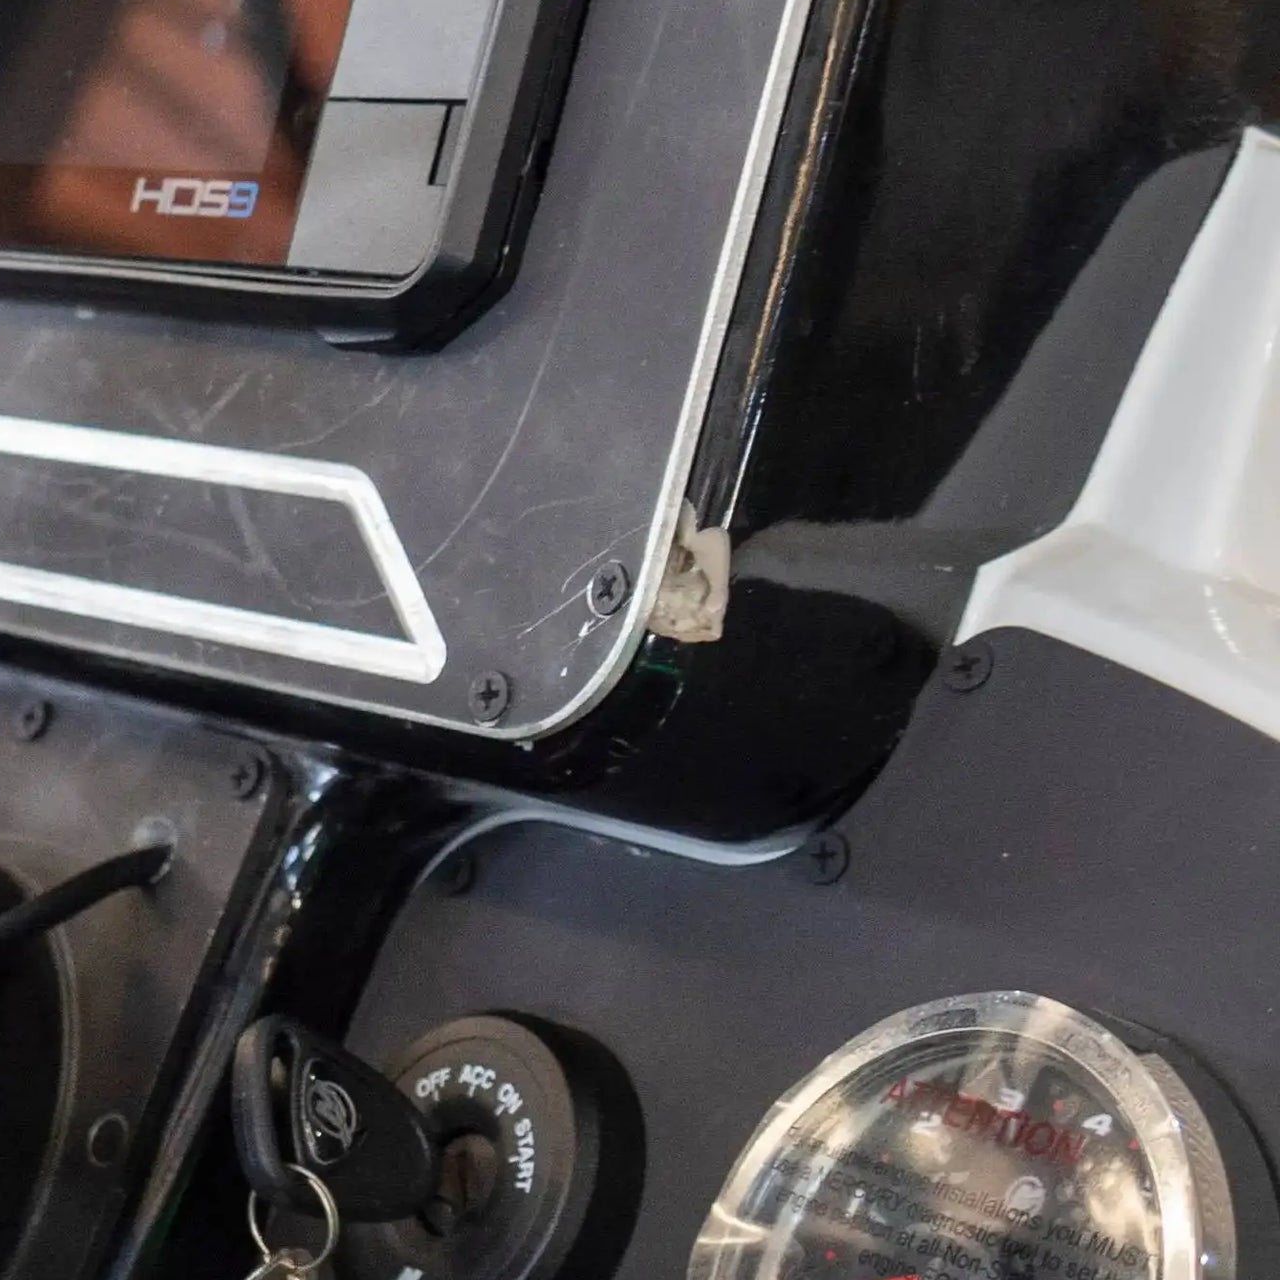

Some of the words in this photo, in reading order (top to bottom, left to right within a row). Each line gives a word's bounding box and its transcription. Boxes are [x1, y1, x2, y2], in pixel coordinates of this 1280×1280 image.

[415, 1067, 451, 1098] OFF
[458, 1064, 496, 1089] ACC
[497, 1083, 523, 1114] ON
[881, 1077, 1082, 1165] ATTENTION
[1081, 1113, 1114, 1136] 4
[514, 1118, 535, 1193] START
[934, 1179, 1041, 1228] installations
[1043, 1221, 1086, 1250] you
[1086, 1230, 1152, 1271] MUST
[918, 1234, 942, 1256] all
[858, 1249, 917, 1280] engine
